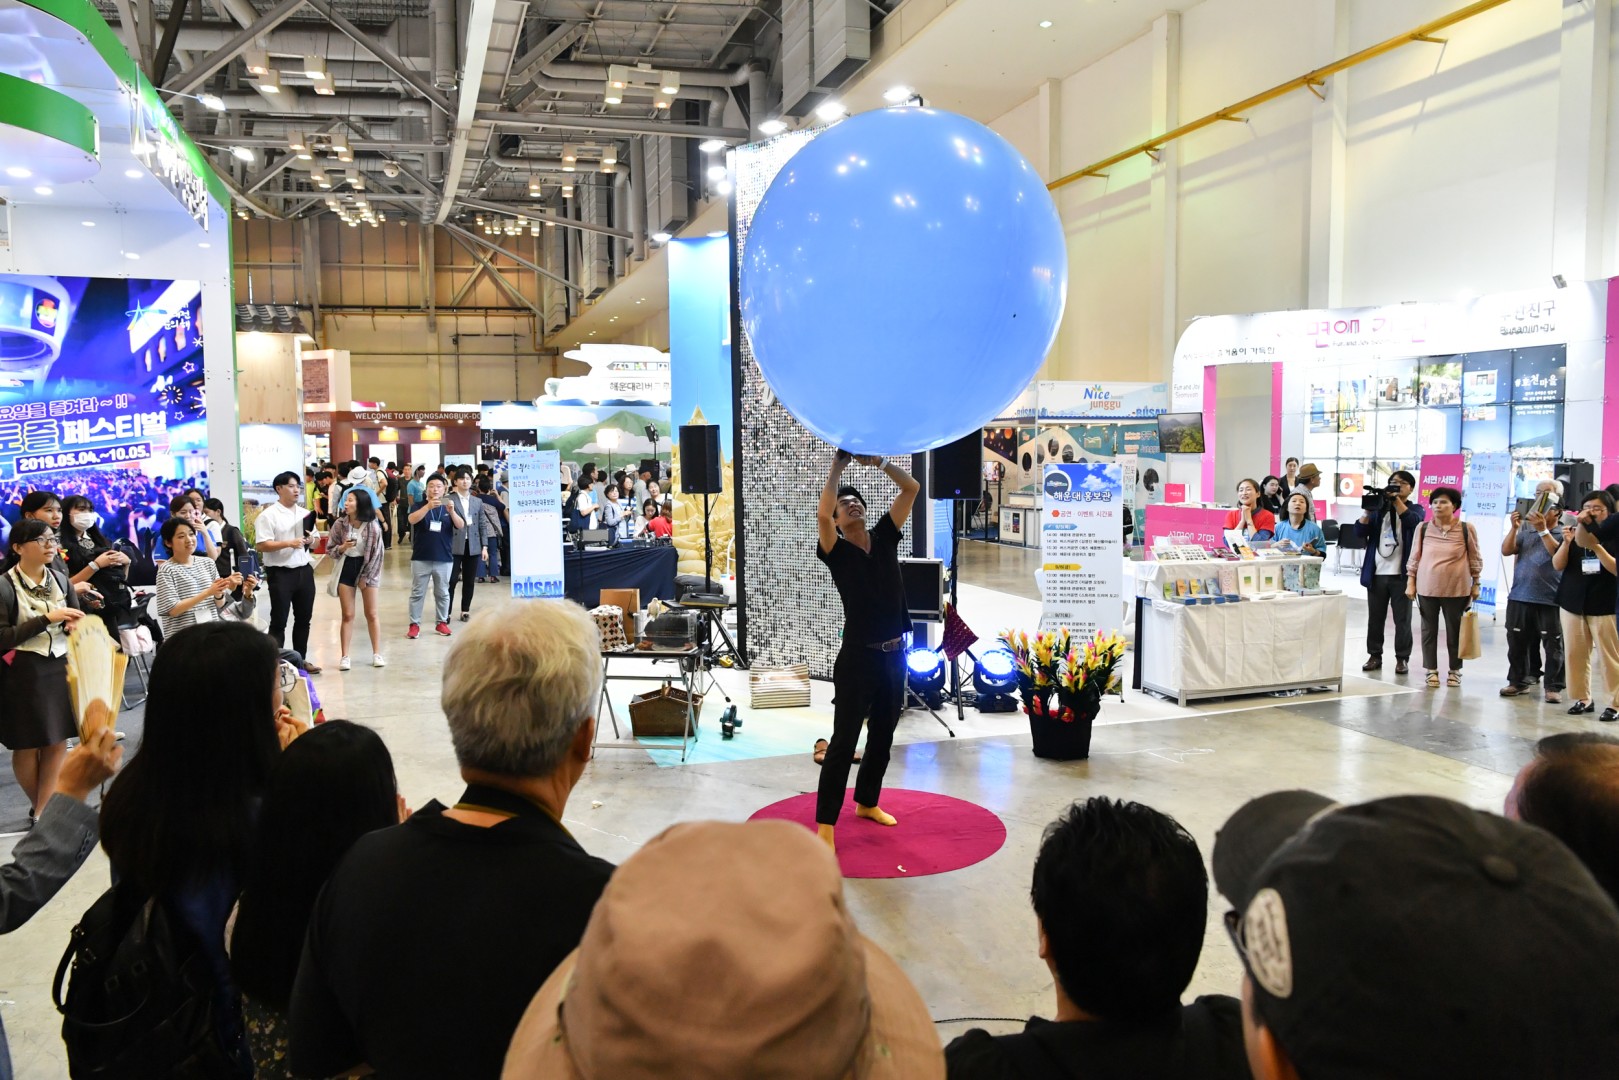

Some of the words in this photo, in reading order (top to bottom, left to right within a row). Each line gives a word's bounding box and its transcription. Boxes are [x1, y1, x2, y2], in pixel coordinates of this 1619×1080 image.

[1083, 387, 1110, 400] Nice
[50, 396, 98, 416] 즐겨라
[1089, 399, 1121, 411] junggu
[355, 412, 392, 420] WELCOME
[395, 412, 404, 420] TO
[63, 410, 168, 445] 페스티벌
[1053, 490, 1081, 502] 해운대
[1083, 490, 1113, 502] 홍보관
[1060, 510, 1072, 518] 공연
[1077, 510, 1094, 518] 이벤트
[513, 579, 563, 598] BUSAN
